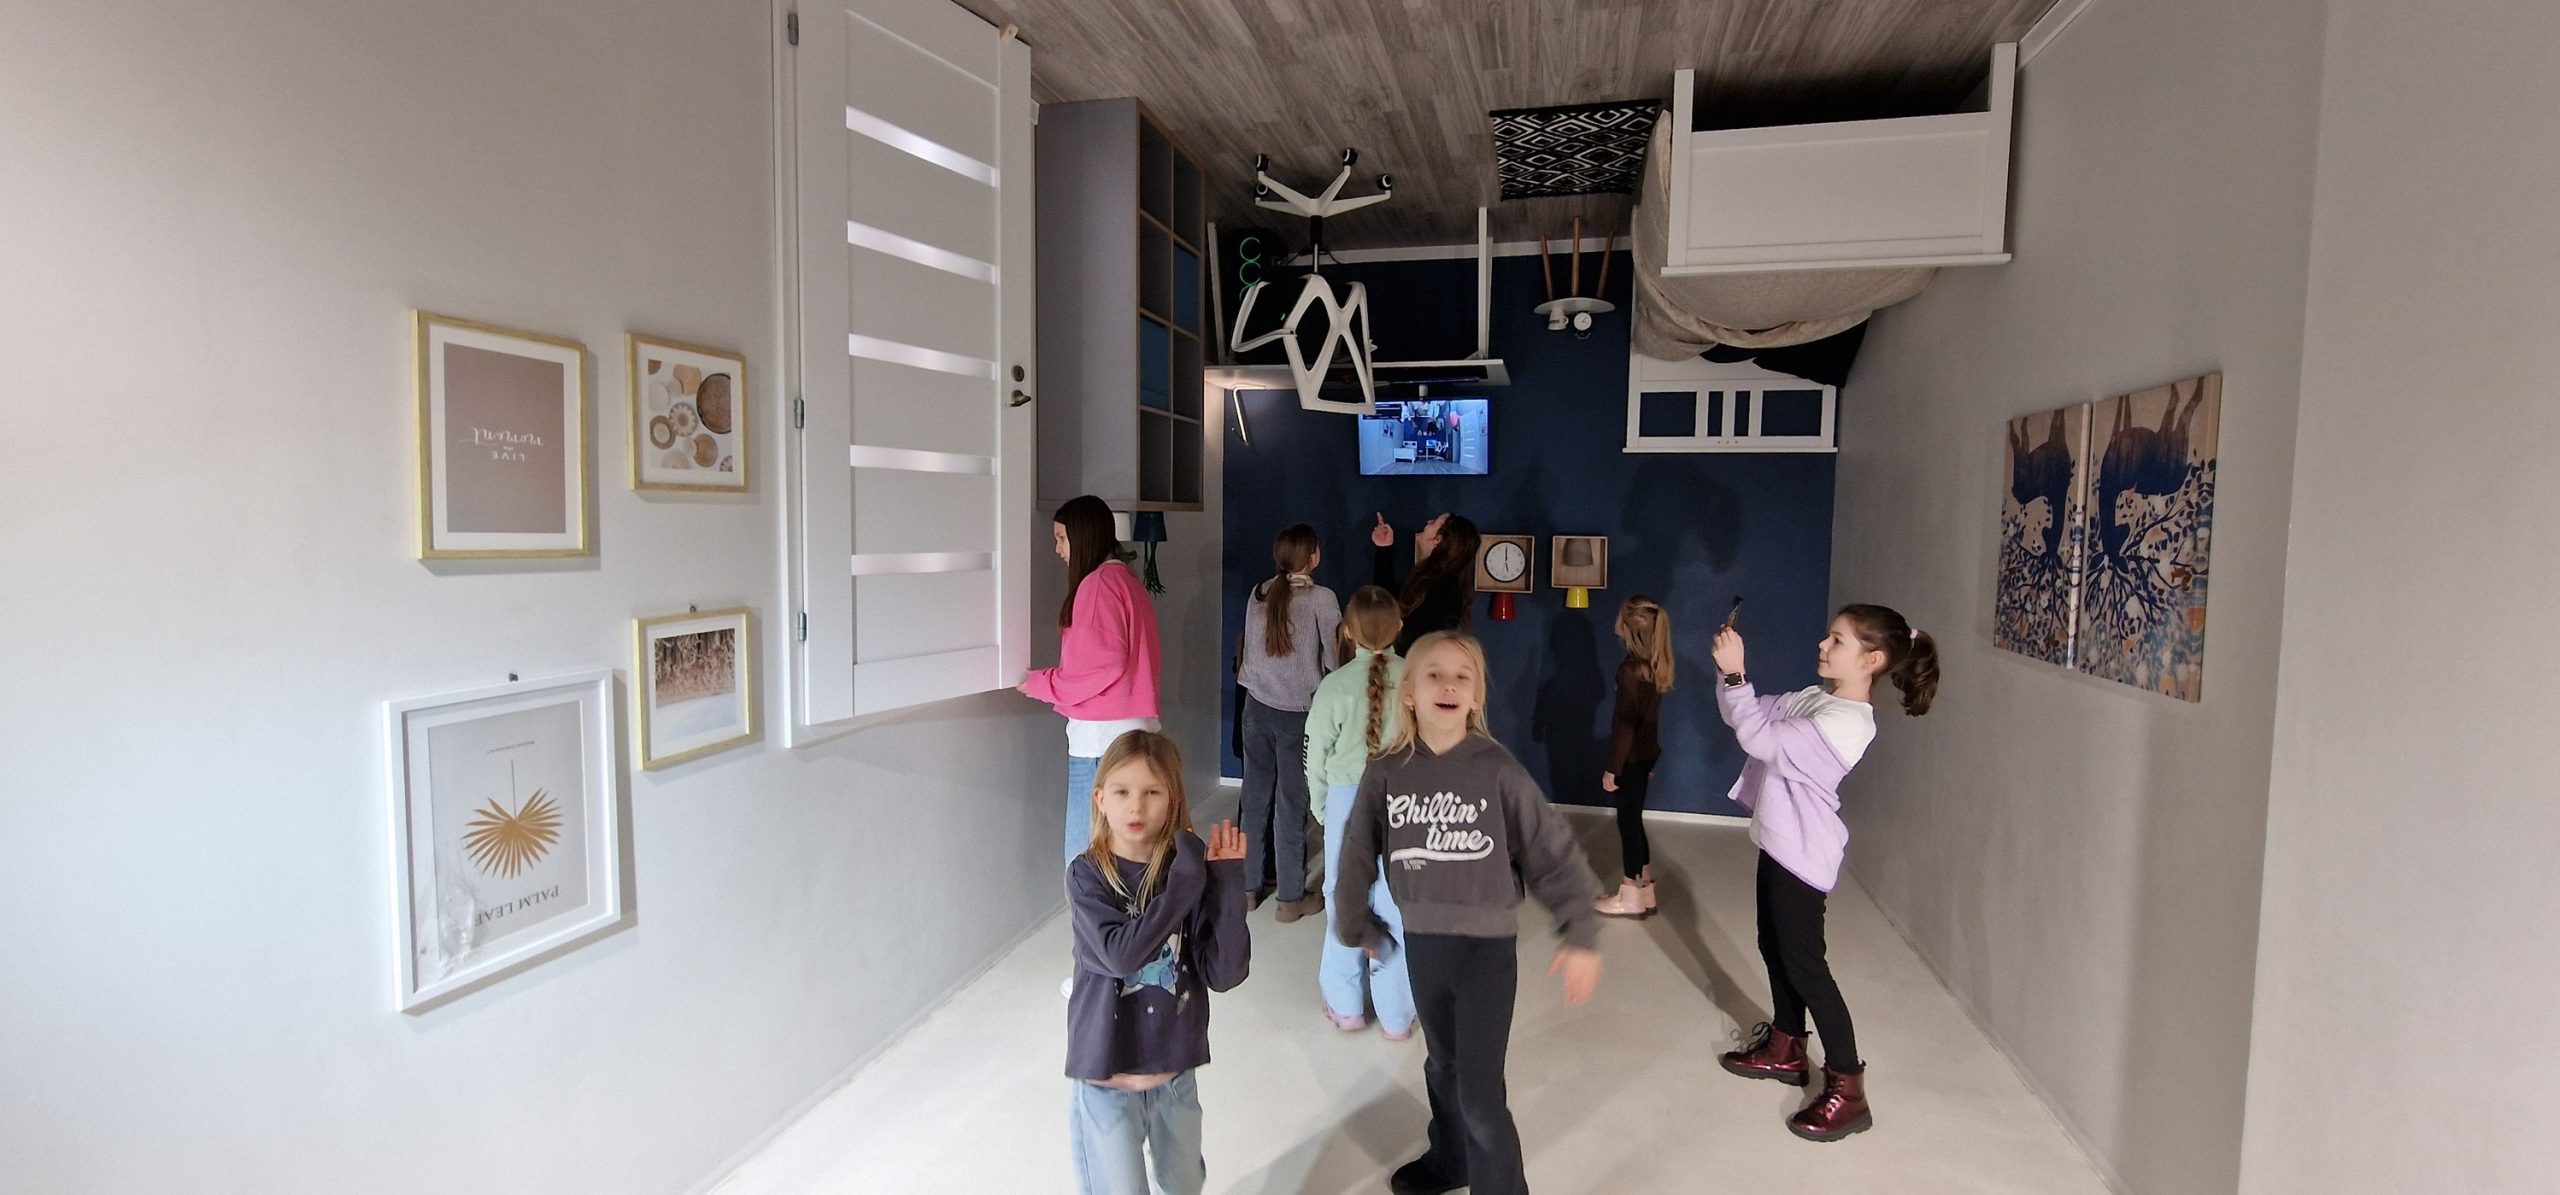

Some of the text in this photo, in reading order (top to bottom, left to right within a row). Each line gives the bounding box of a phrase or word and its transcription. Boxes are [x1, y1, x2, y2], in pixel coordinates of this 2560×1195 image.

[459, 427, 544, 447] moment
[491, 451, 525, 462] LIVE
[1387, 791, 1488, 829] Chillin'
[1426, 823, 1494, 854] time
[518, 884, 560, 910] PALM
